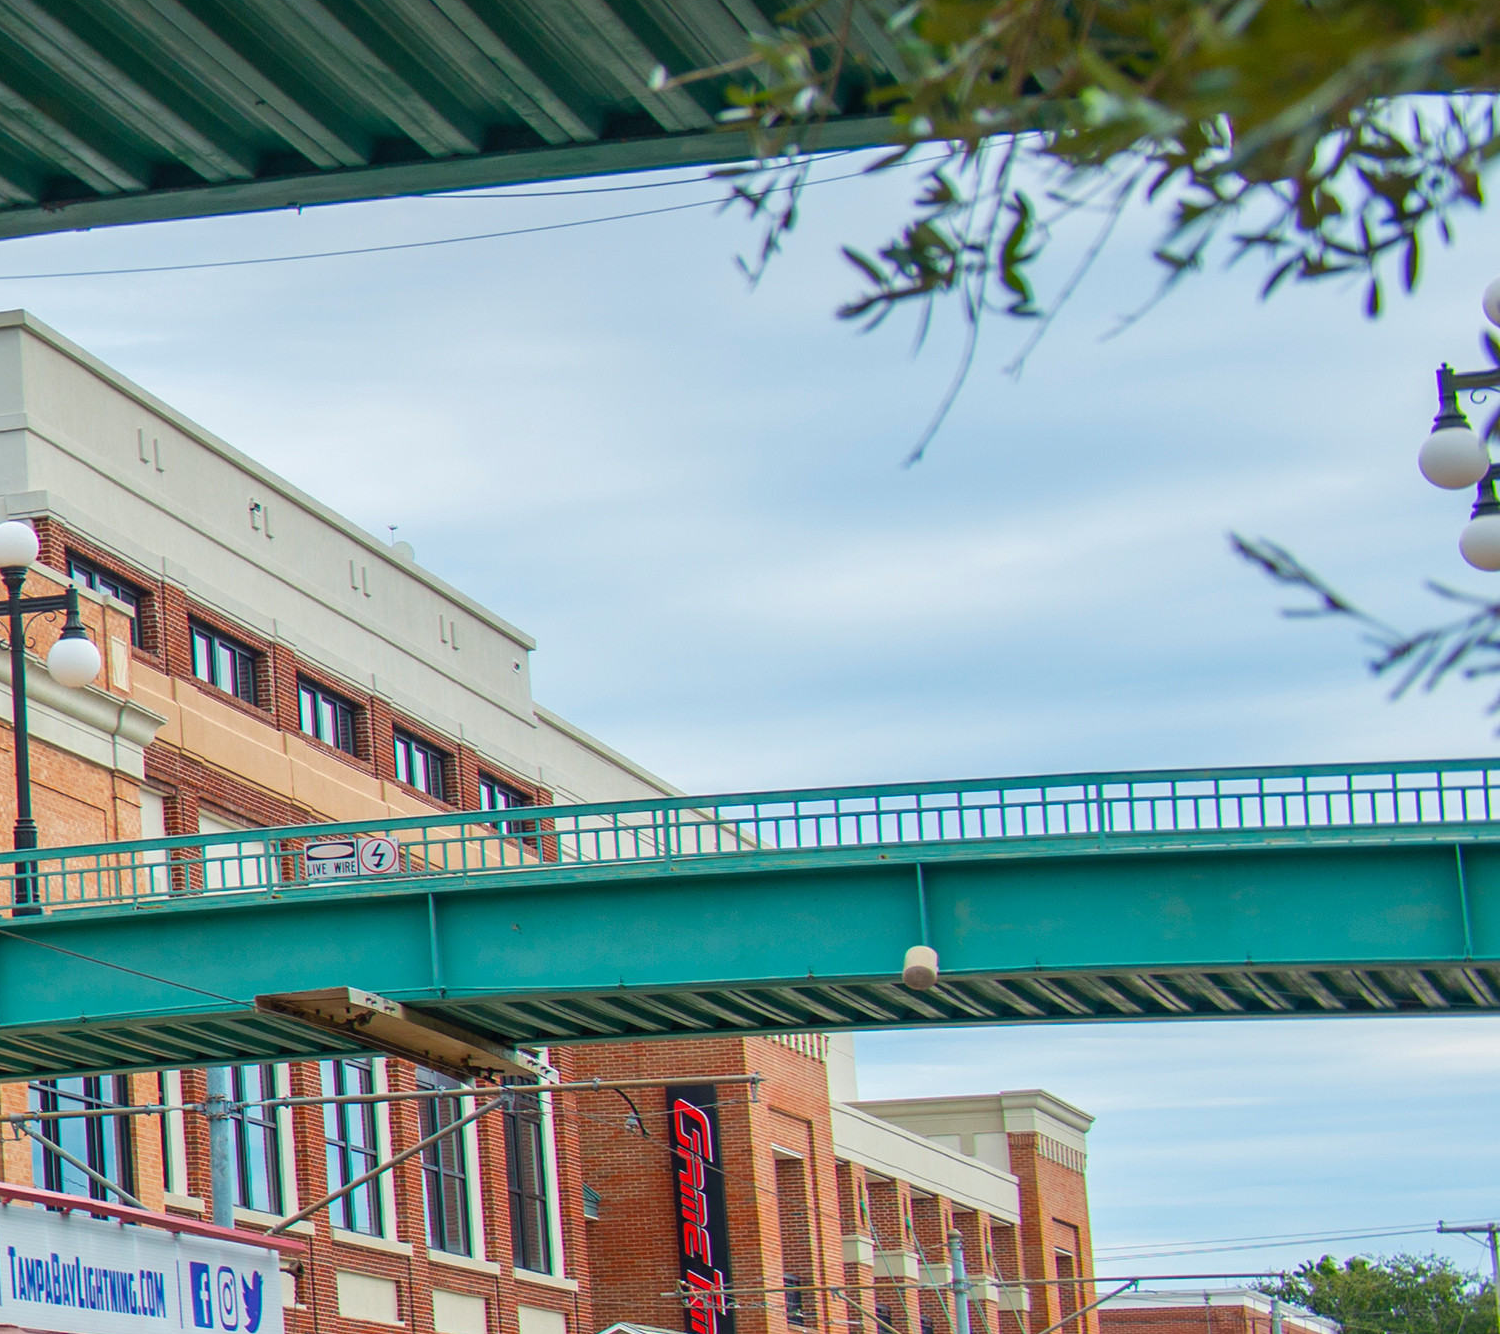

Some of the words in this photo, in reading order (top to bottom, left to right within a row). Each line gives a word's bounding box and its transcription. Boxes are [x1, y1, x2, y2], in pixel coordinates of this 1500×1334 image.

[306, 862, 327, 877] LIVE
[333, 860, 356, 874] WIRE
[673, 1097, 714, 1268] GAME
